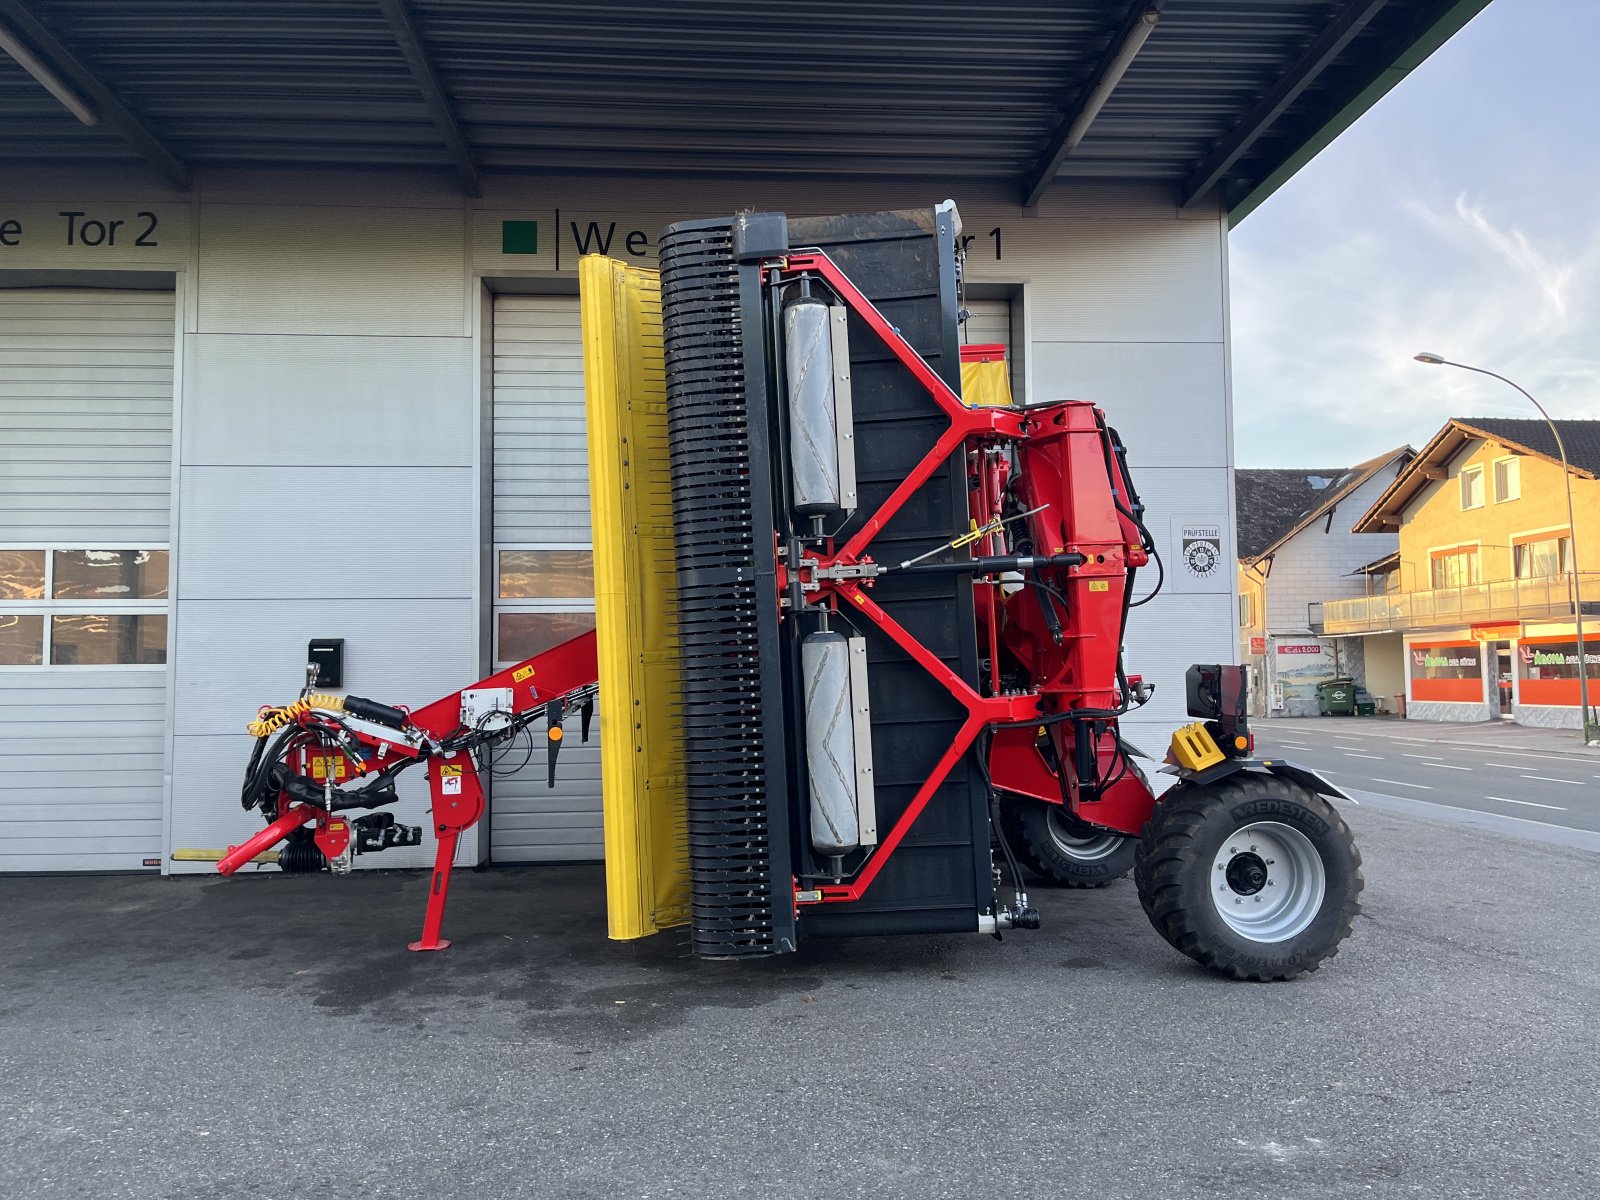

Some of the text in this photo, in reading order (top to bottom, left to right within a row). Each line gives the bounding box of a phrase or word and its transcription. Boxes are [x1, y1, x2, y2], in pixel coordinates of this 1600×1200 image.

[58, 211, 124, 246] Tor
[135, 211, 158, 247] 2
[989, 227, 1001, 260] 1
[1183, 528, 1218, 537] PRÜFSTELLE
